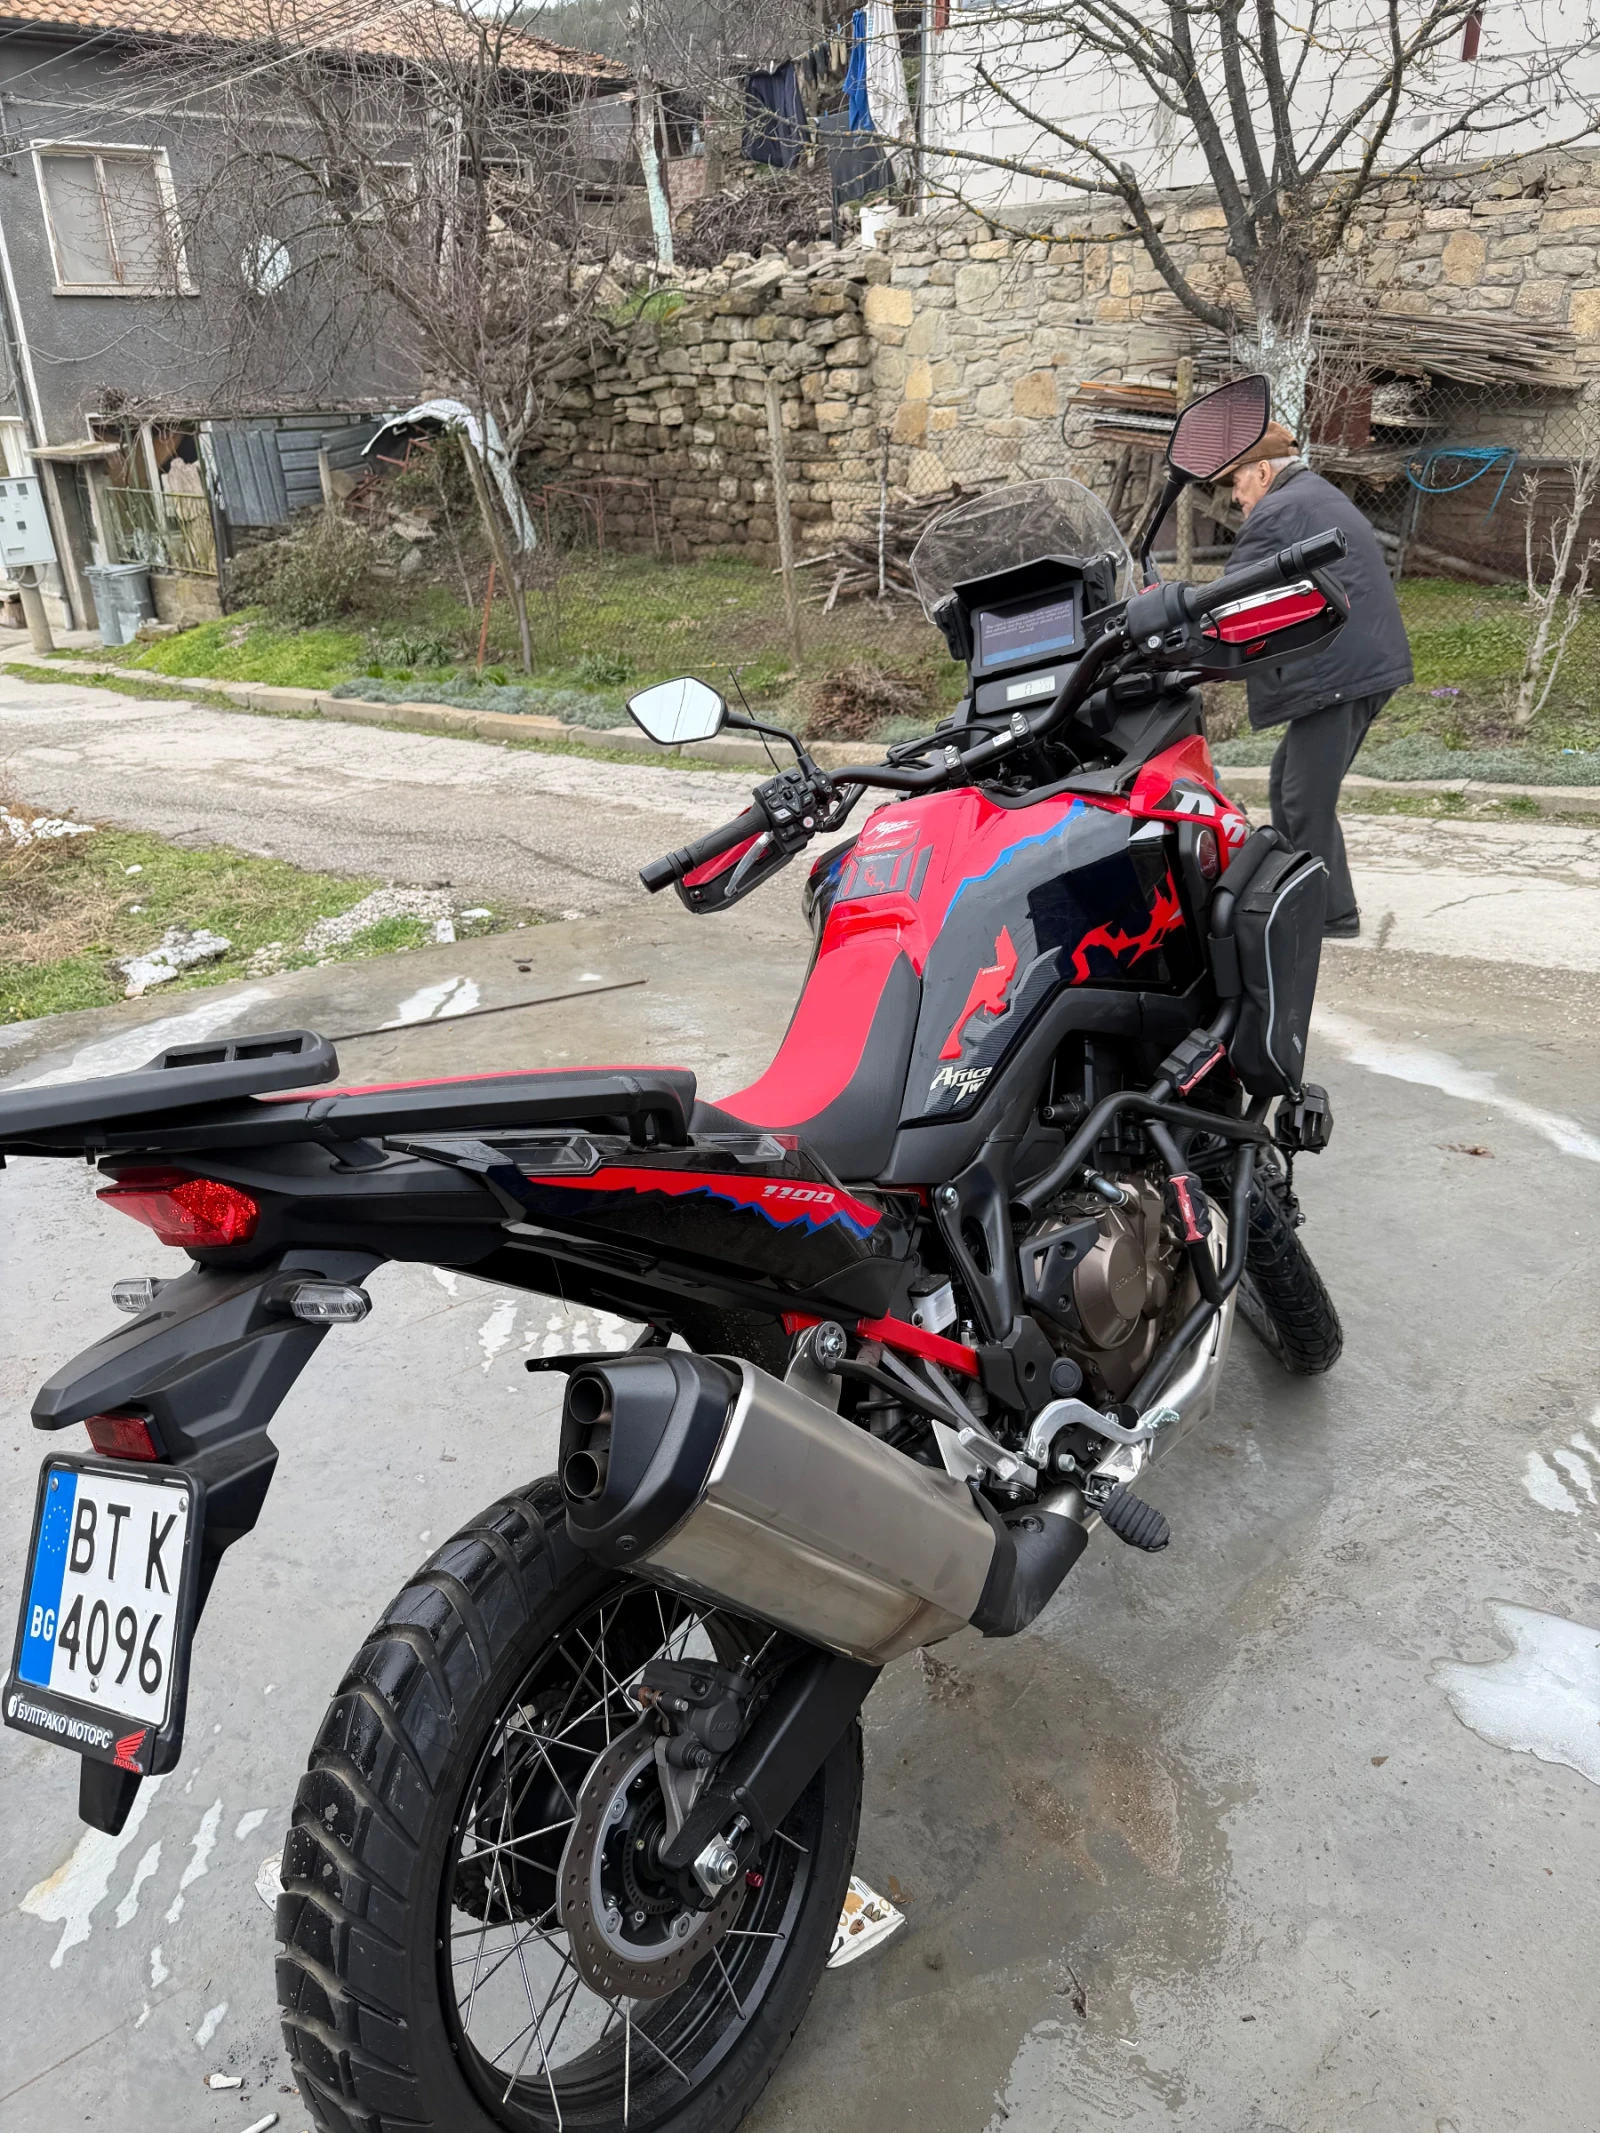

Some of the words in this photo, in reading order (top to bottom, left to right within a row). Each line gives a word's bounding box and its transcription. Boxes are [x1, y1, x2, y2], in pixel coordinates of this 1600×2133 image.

[930, 1066, 992, 1090] Africa
[761, 1185, 836, 1204] 1100
[144, 1511, 178, 1595] K
[30, 1604, 55, 1641] BG
[58, 1593, 163, 1695] 4096
[17, 1702, 67, 1734] БУЛТРАКО
[67, 1719, 112, 1749] МОТОРС
[113, 1757, 142, 1774] HONDA
